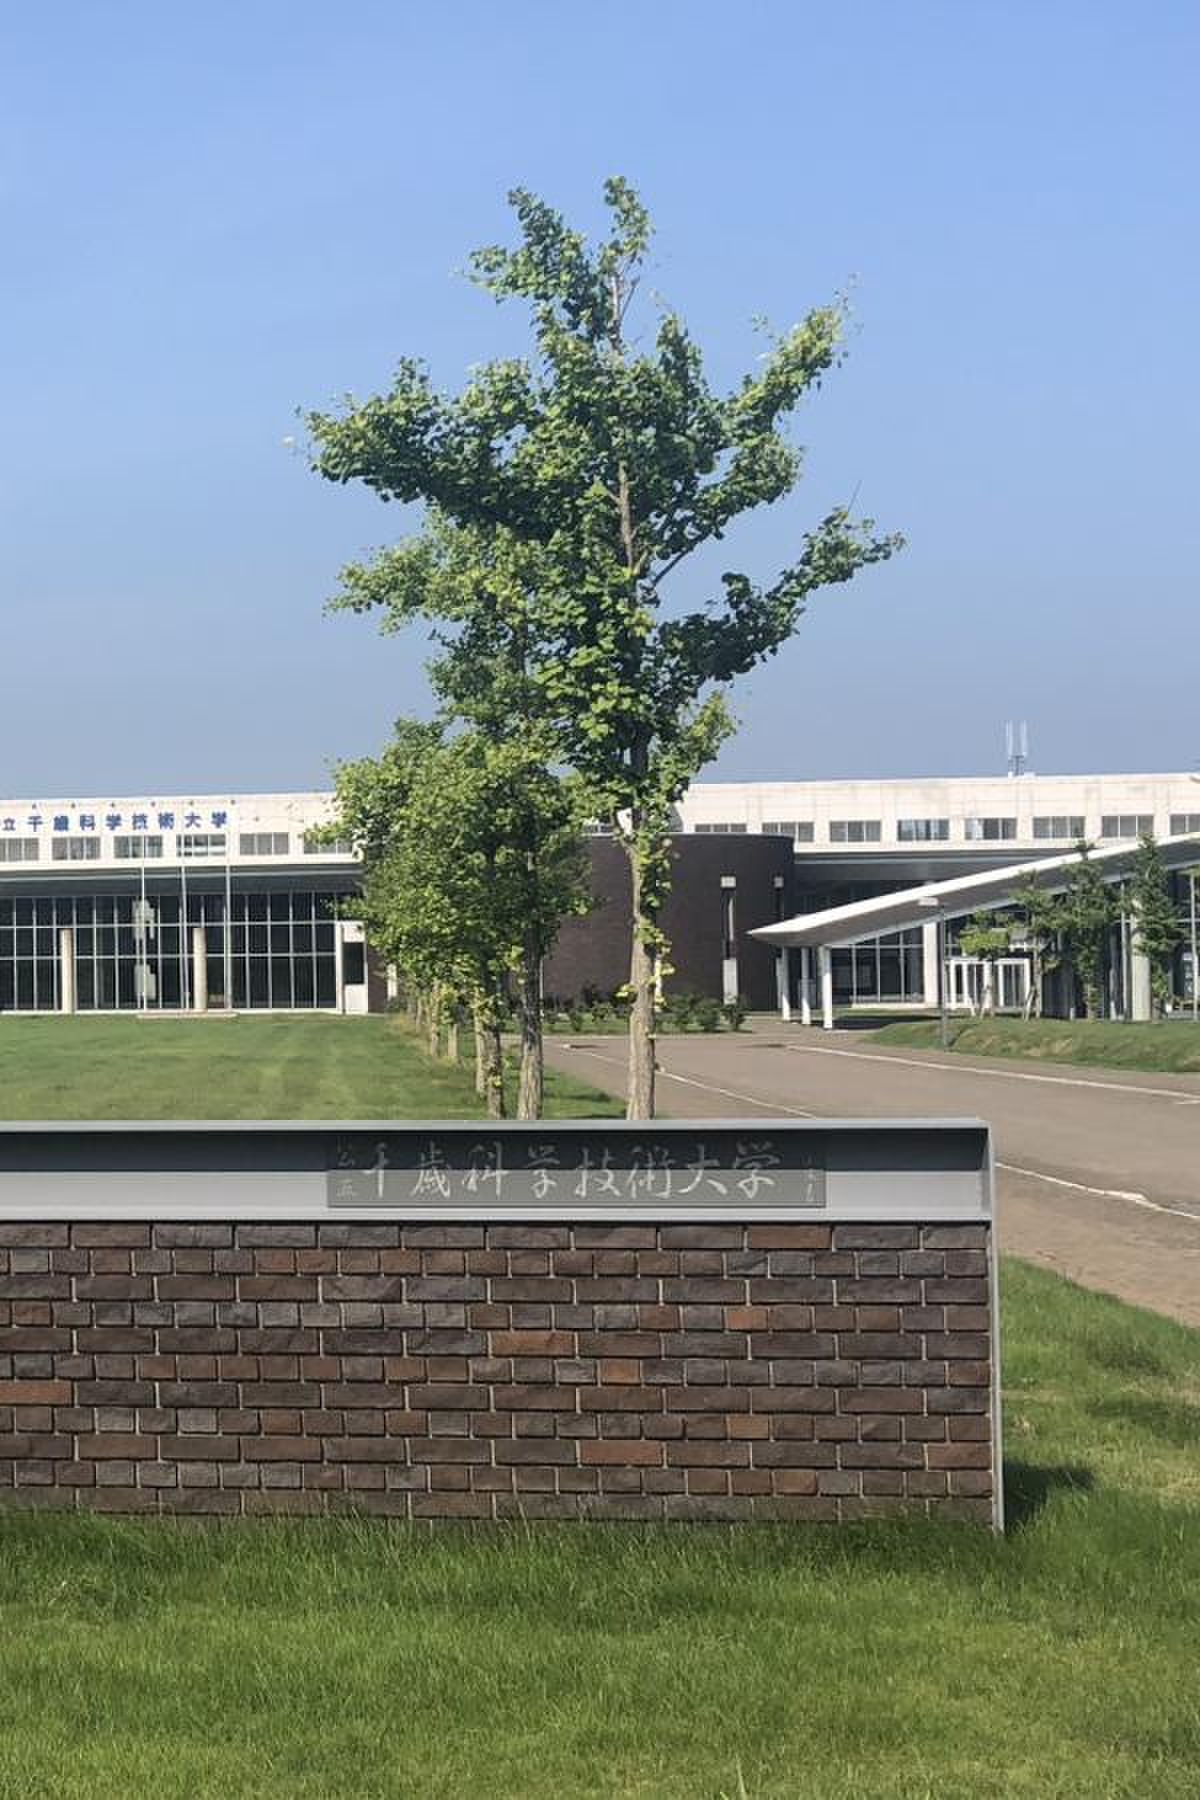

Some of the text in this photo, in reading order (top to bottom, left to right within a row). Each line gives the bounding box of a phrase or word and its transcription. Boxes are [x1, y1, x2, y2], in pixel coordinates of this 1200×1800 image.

[362, 1140, 781, 1199] 千歳科学技術大学
